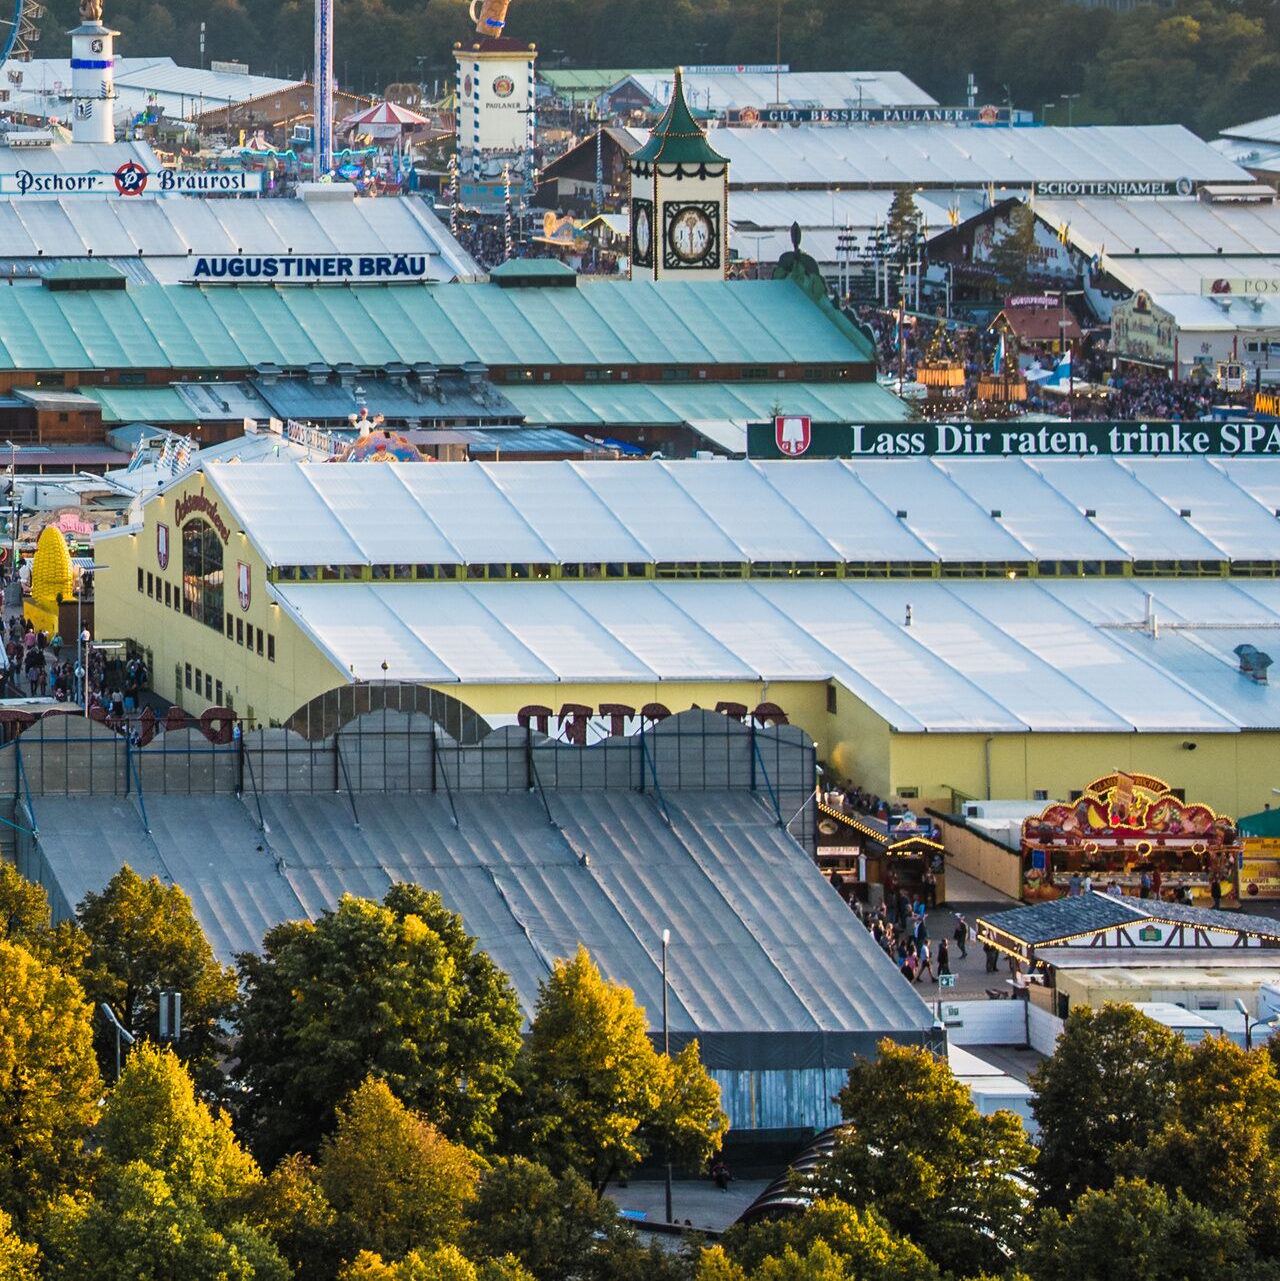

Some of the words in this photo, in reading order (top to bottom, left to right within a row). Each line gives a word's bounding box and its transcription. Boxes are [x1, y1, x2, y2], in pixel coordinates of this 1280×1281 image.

[769, 111, 803, 122] GUT,
[810, 111, 876, 122] BESSER,
[884, 110, 969, 121] PAULANER.
[15, 169, 104, 196] Pschorr-
[157, 169, 246, 190] Bräurosl
[1038, 182, 1170, 195] SCHOTTENHAMEL
[193, 257, 354, 277] AUGUSTINER
[358, 254, 426, 276] BRÄU
[851, 425, 925, 454] Lass
[935, 424, 991, 453] Dir
[1002, 424, 1098, 456] raten,
[1109, 423, 1210, 453] trinke
